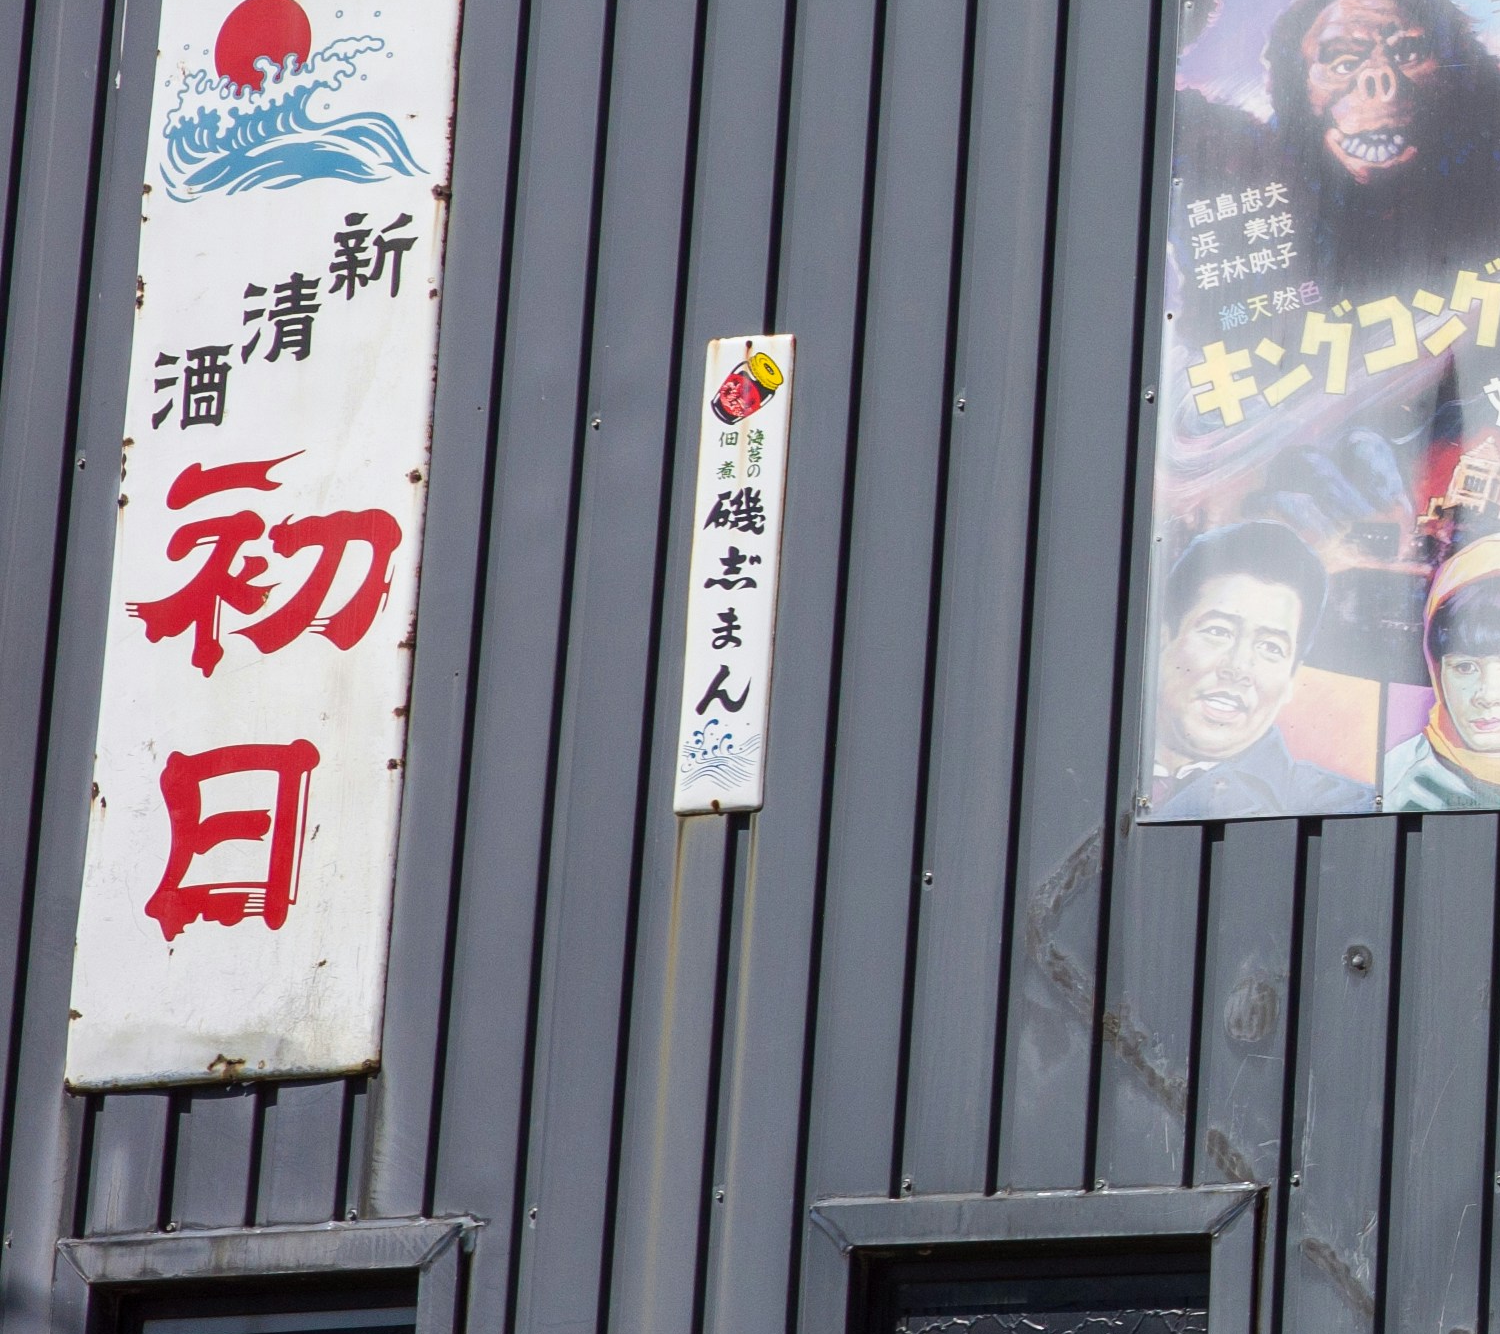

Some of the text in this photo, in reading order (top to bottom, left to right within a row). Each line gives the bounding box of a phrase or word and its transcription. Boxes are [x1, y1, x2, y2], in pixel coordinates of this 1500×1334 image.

[1187, 182, 1289, 227] 高島忠夫
[1194, 242, 1297, 290] 若林映子
[1218, 281, 1323, 330] 総天然色
[717, 431, 739, 480] 佃煮
[125, 449, 402, 942] 初日
